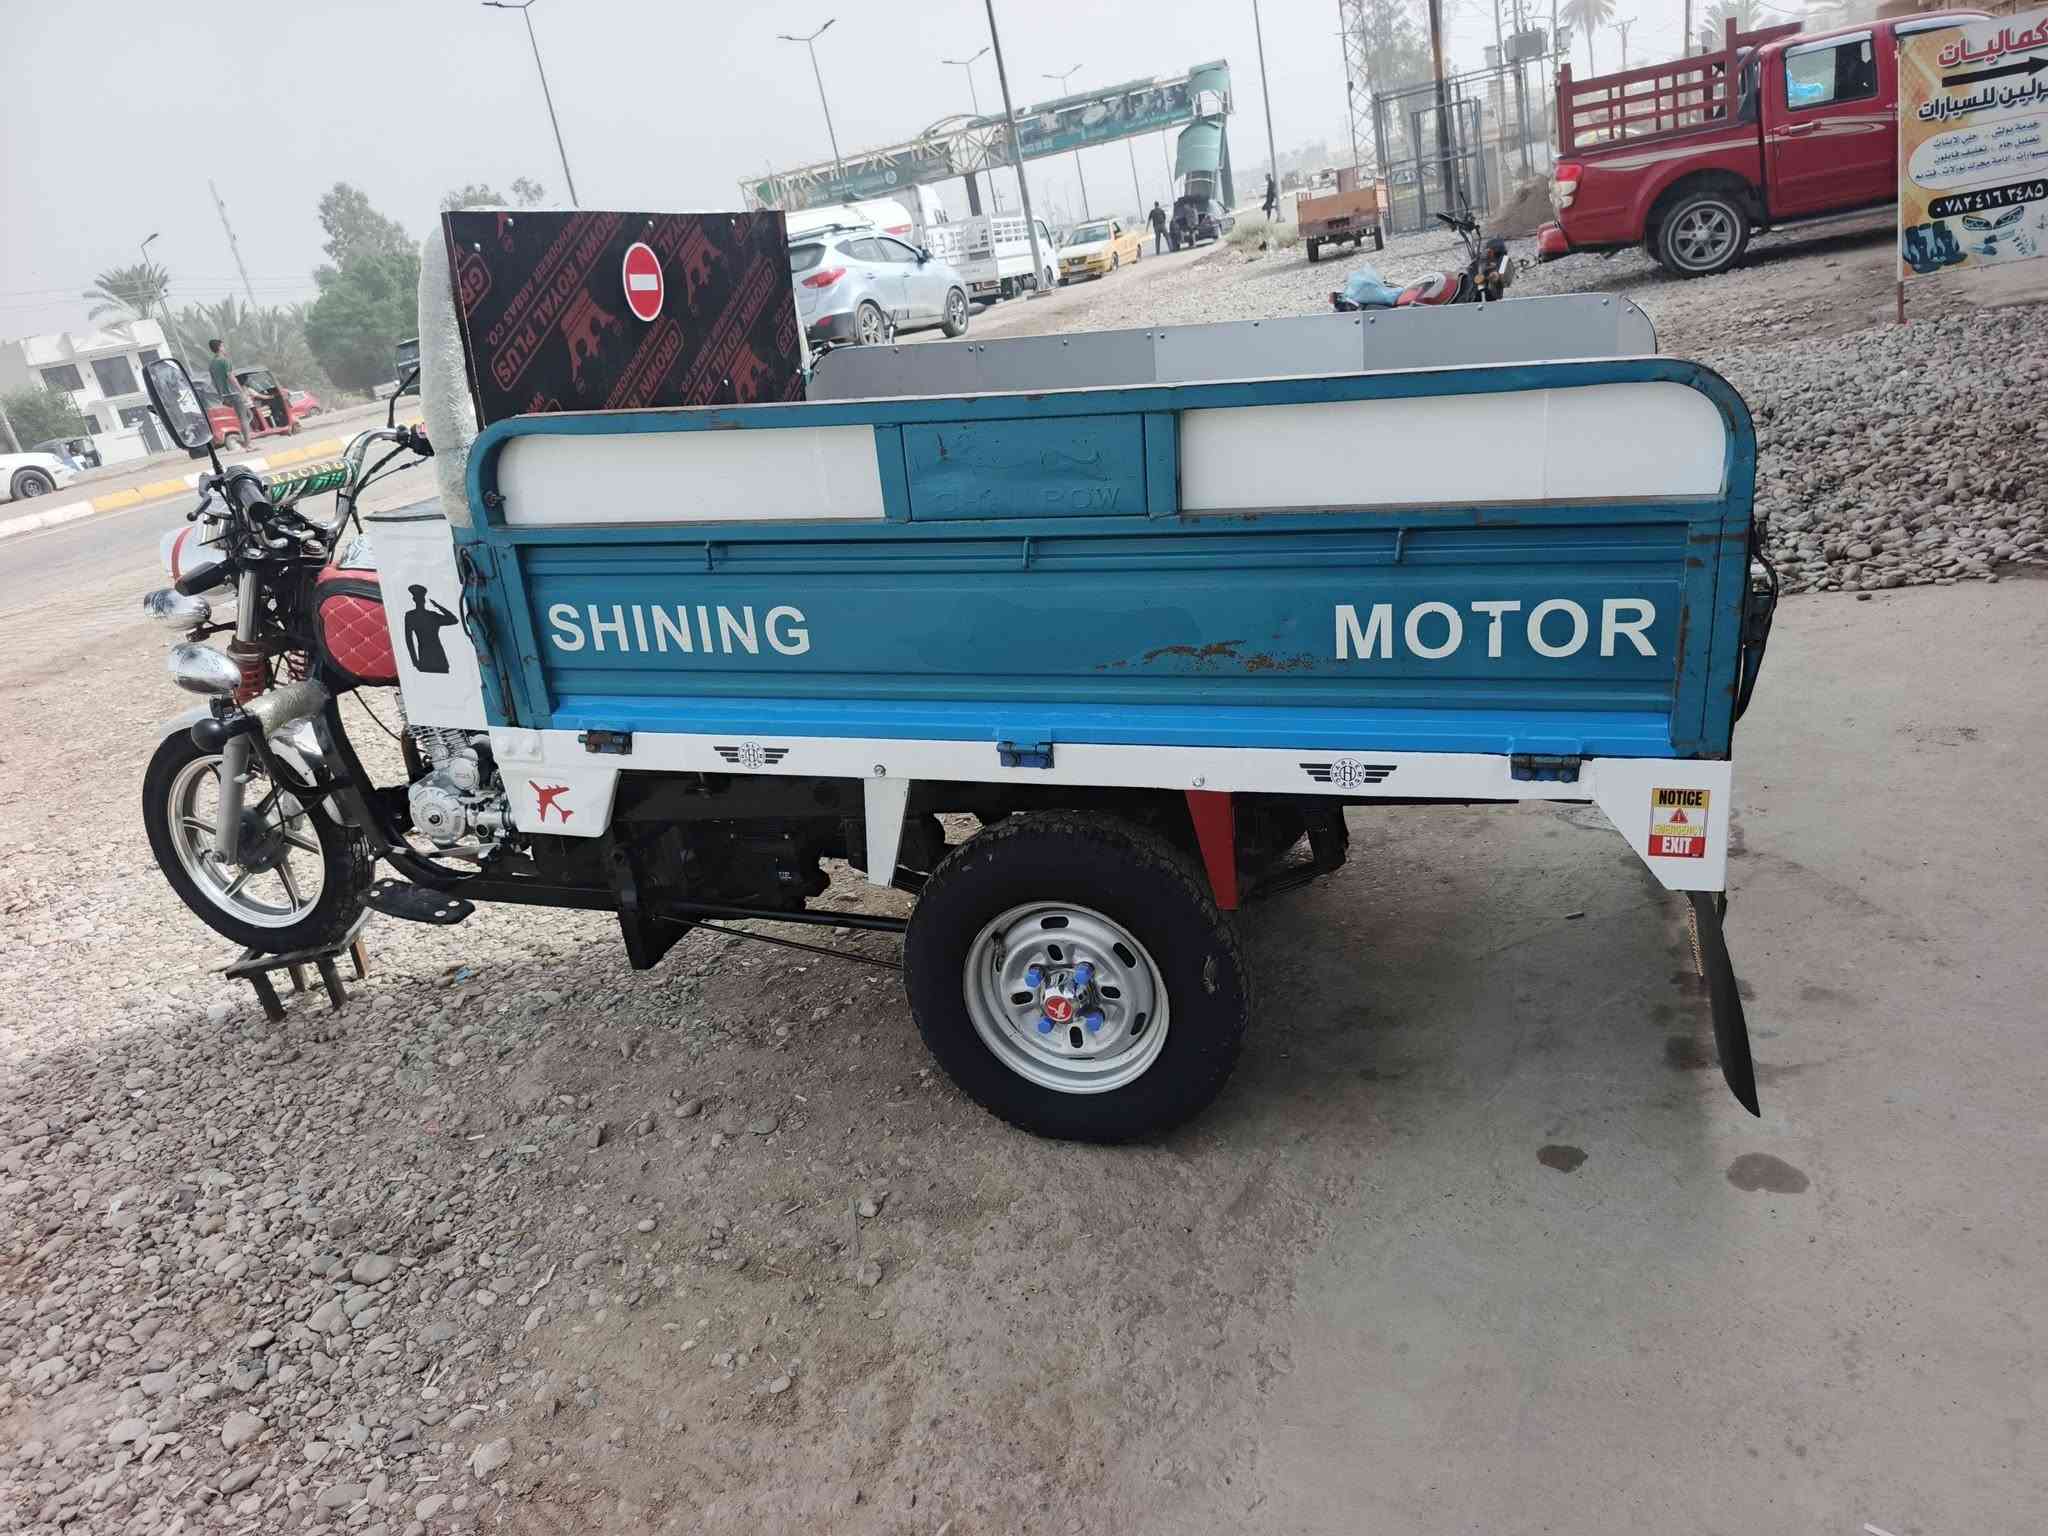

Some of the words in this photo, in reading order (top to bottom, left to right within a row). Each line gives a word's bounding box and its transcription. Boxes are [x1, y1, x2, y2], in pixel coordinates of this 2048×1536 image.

[1919, 87, 1995, 119] للسيارات
[2000, 77, 2048, 104] رلين
[575, 212, 616, 269] ROWN
[533, 263, 579, 327] ROYAL
[496, 322, 537, 384] PLUS
[548, 603, 810, 656] SHINING
[1335, 598, 1657, 660] MOTOR
[1658, 789, 1703, 806] NOTICE
[1662, 836, 1693, 855] EXIT
